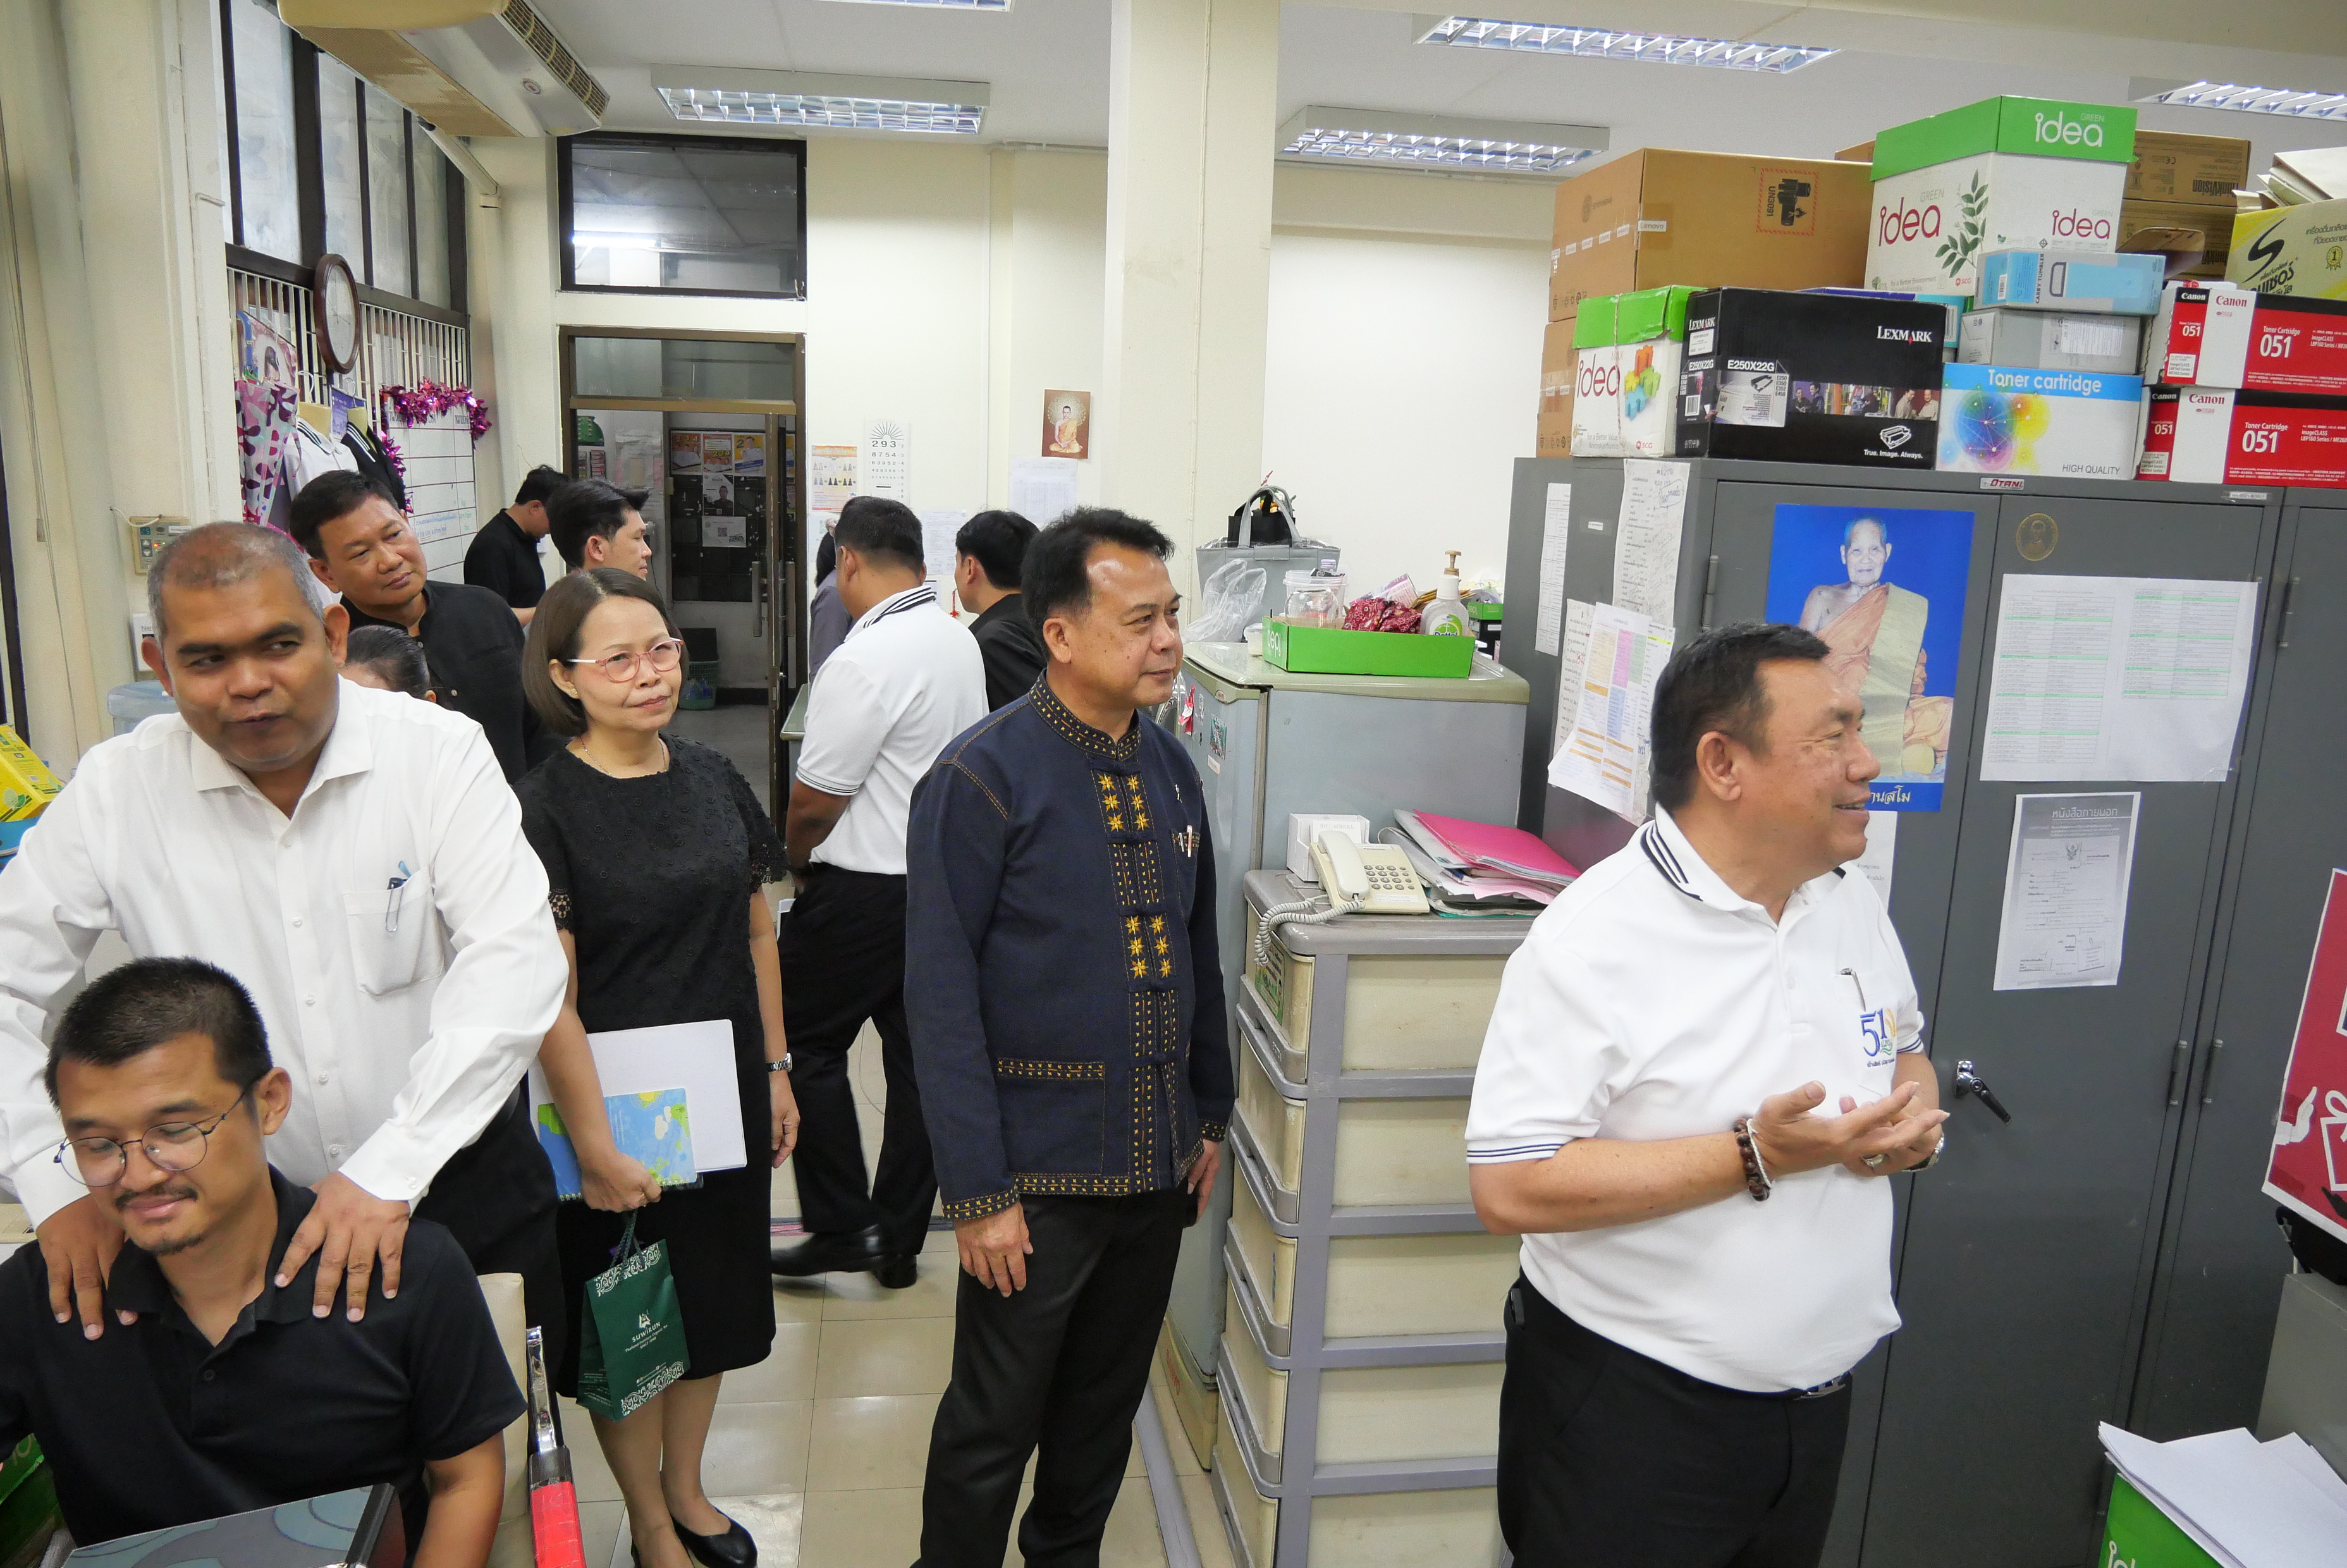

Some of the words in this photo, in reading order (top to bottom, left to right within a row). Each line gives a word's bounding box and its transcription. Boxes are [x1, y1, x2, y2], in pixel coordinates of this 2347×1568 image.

[2080, 113, 2104, 122] GREEN
[2035, 111, 2104, 148] idea
[1767, 186, 1776, 216] UN3091
[1920, 188, 1944, 202] GREEN
[1878, 197, 1941, 247] idea
[2052, 208, 2111, 240] idea
[2332, 250, 2338, 262] 1
[2181, 292, 2205, 300] Canon
[2216, 295, 2247, 307] Canon
[1689, 317, 1715, 331] LEXMARK
[1877, 326, 1932, 344] LEXMARK
[2183, 326, 2201, 336] 051
[2277, 327, 2301, 336] Cartridge
[2260, 334, 2291, 358] 051
[1689, 359, 1714, 371] E250X22G
[1727, 360, 1775, 372] E250X22G
[1577, 353, 1621, 398] idea
[1988, 369, 2030, 388] Toner
[2033, 374, 2102, 396] cartridge
[2189, 393, 2225, 405] Canon
[2155, 424, 2173, 434] 051
[2262, 423, 2288, 431] Cartridge
[736, 439, 744, 449] 2
[2242, 431, 2278, 453] 051
[1879, 450, 1899, 459] Image.
[1900, 451, 1923, 460] Always.
[2062, 464, 2083, 474] HIGH
[2085, 465, 2121, 475] QUALITY
[1267, 630, 1281, 658] idea
